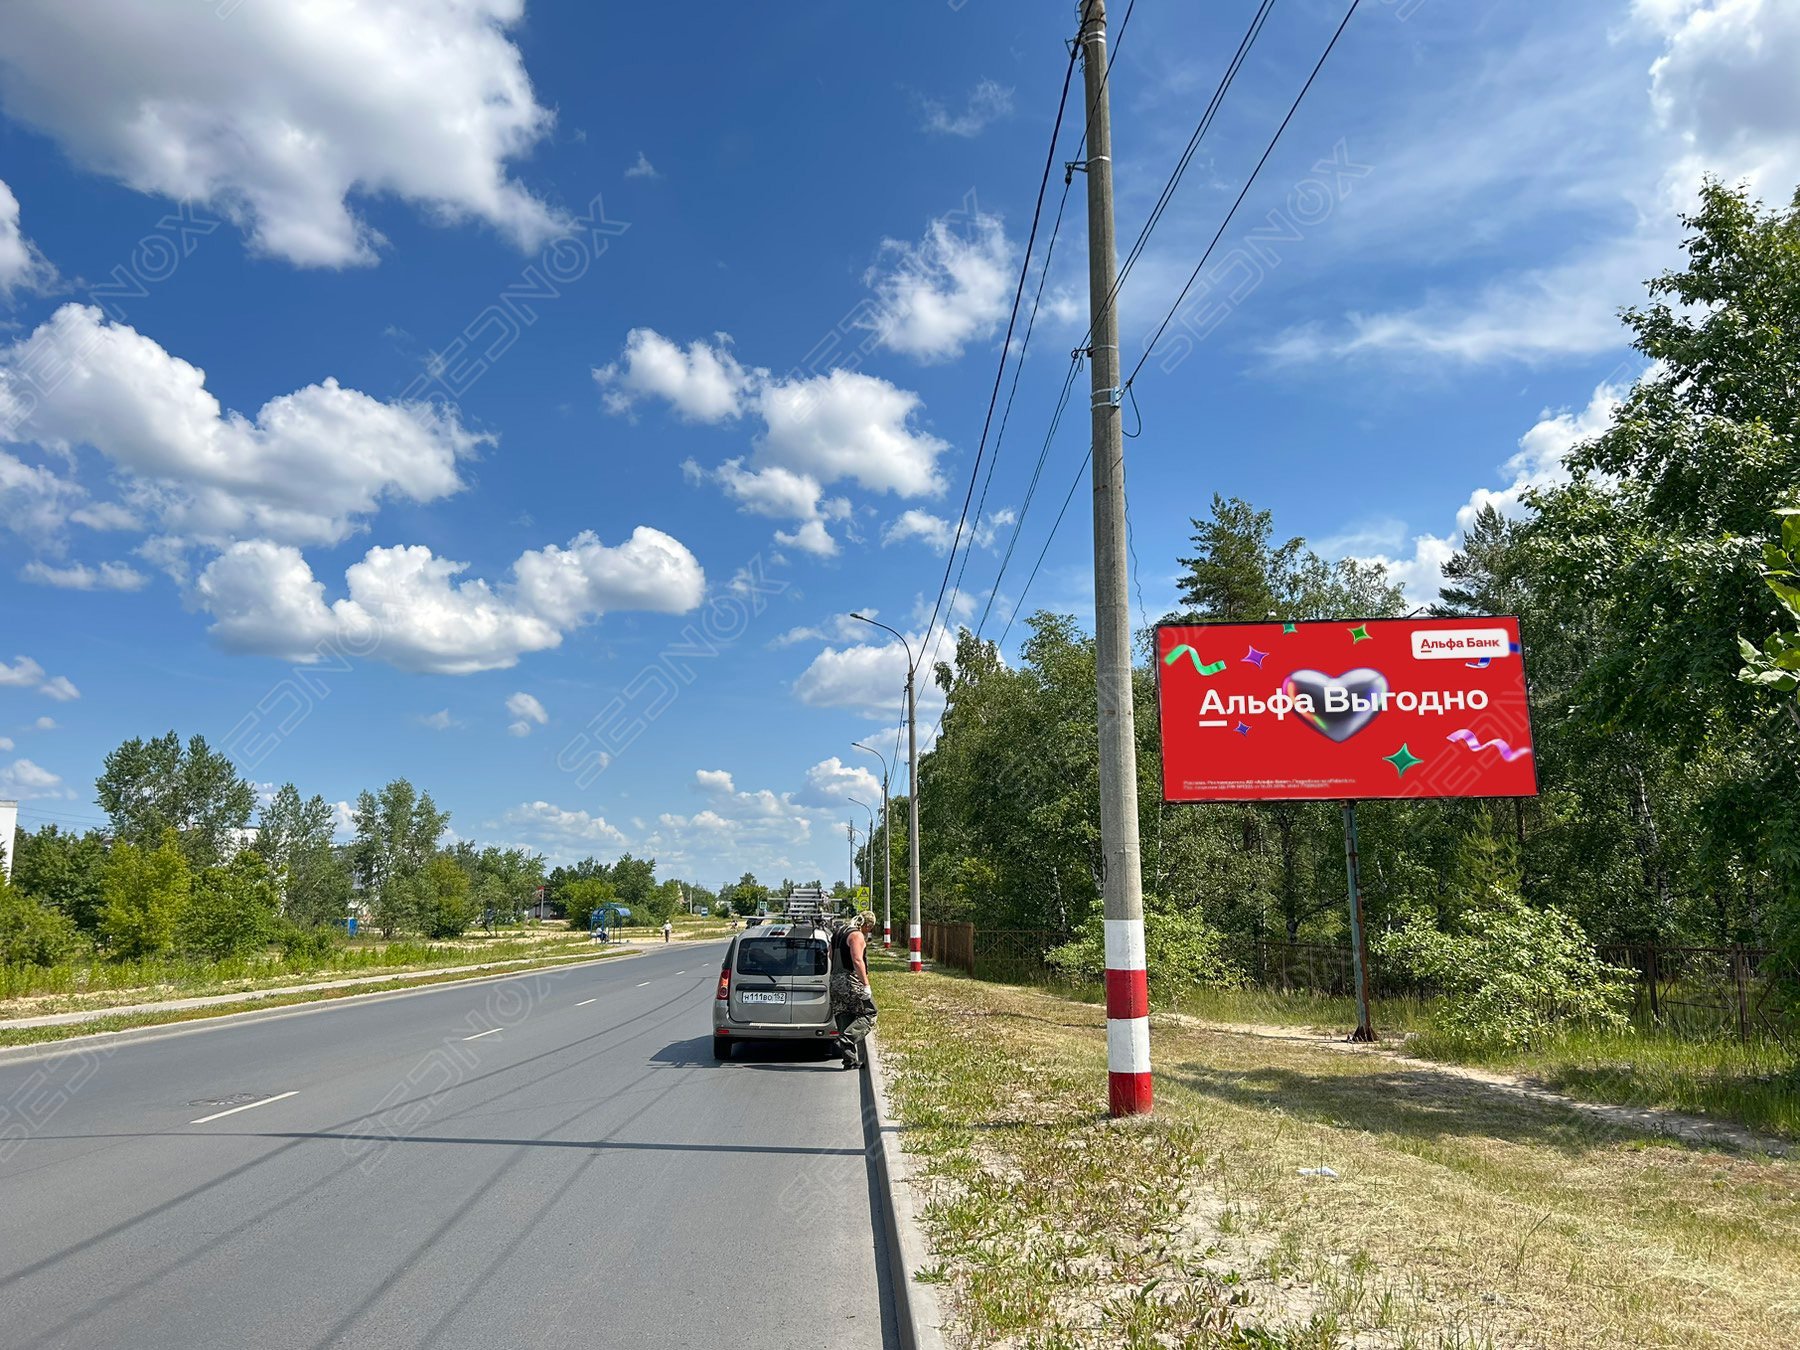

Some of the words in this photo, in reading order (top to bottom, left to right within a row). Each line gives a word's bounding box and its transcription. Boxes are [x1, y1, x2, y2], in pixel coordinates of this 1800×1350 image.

[1420, 638, 1464, 651] Альфа
[1467, 638, 1500, 648] Банк
[1199, 687, 1315, 721] Альфа
[1324, 686, 1489, 716] Выгодно
